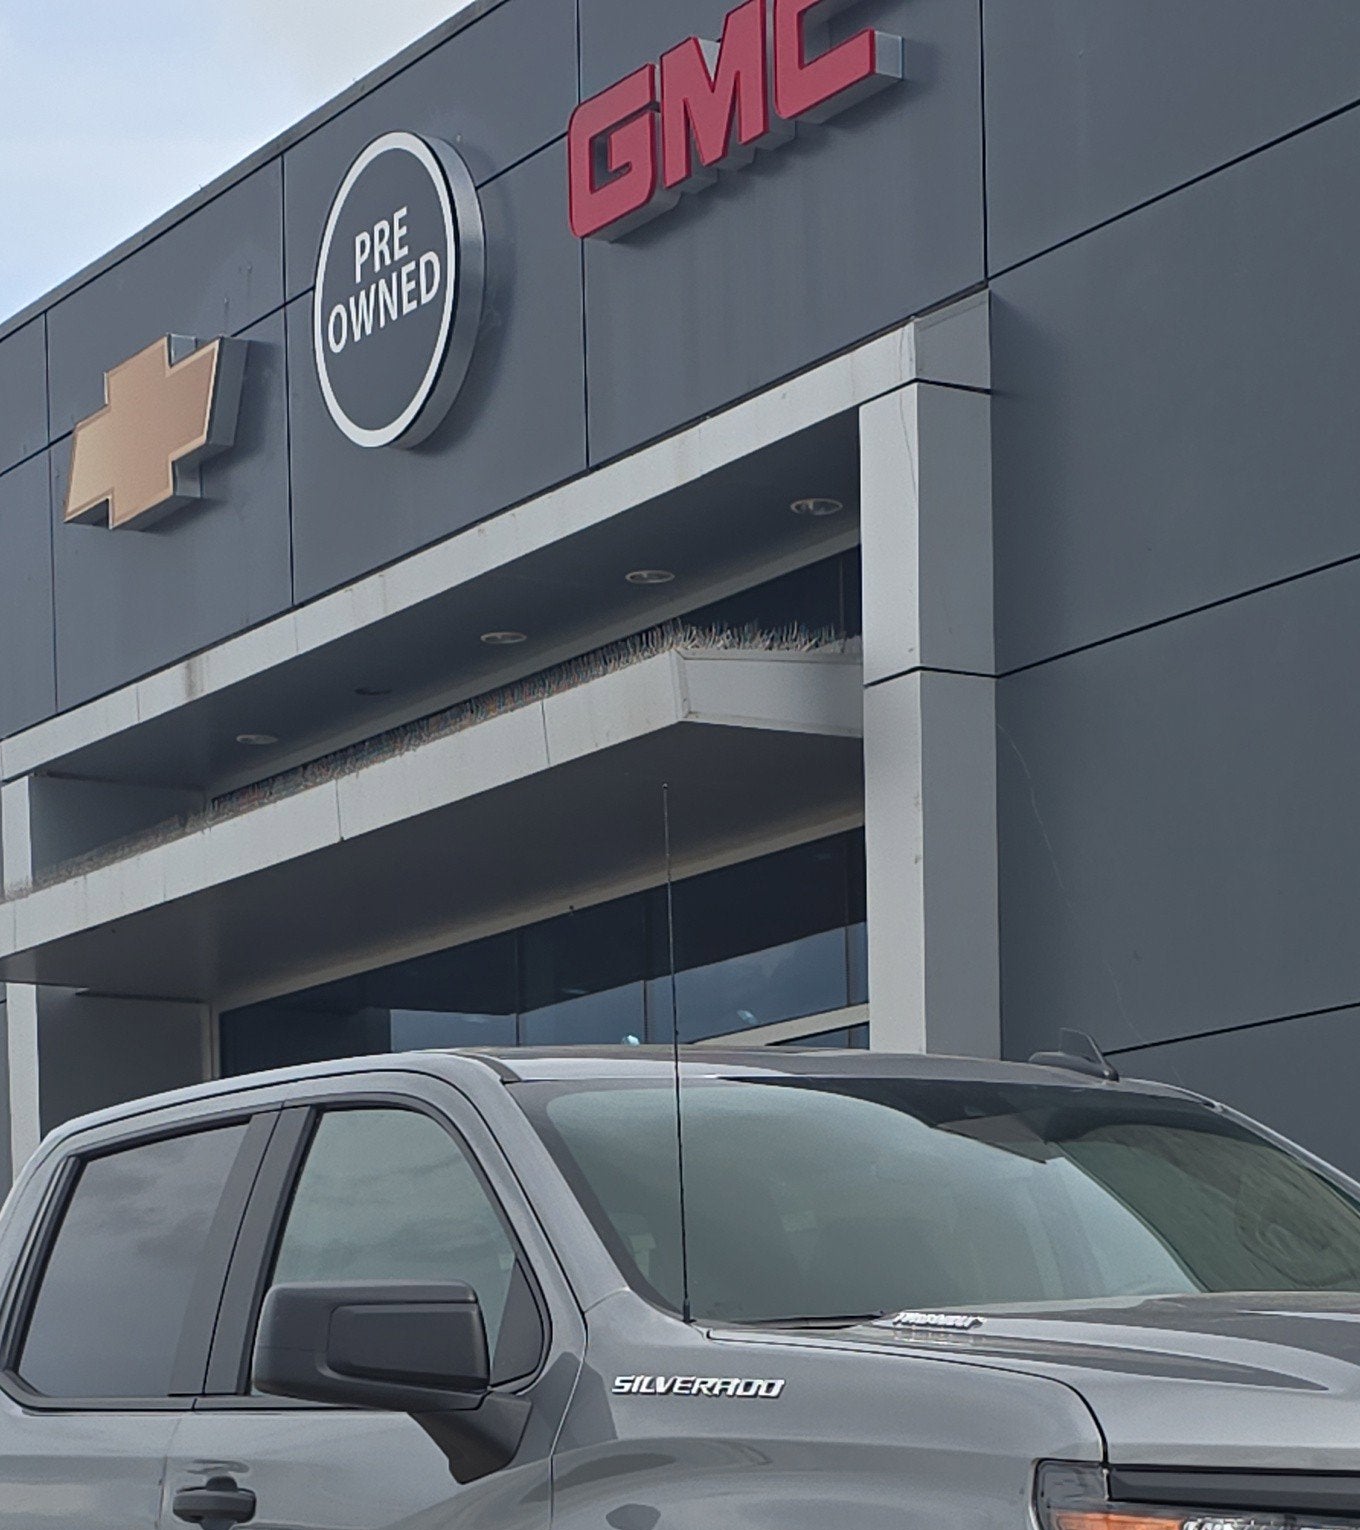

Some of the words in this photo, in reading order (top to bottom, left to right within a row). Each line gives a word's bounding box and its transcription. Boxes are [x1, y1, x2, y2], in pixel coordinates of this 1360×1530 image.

[567, 0, 877, 239] GMC
[354, 205, 409, 284] PRE
[327, 250, 441, 354] OWNED
[611, 1374, 787, 1399] SILVERADO
